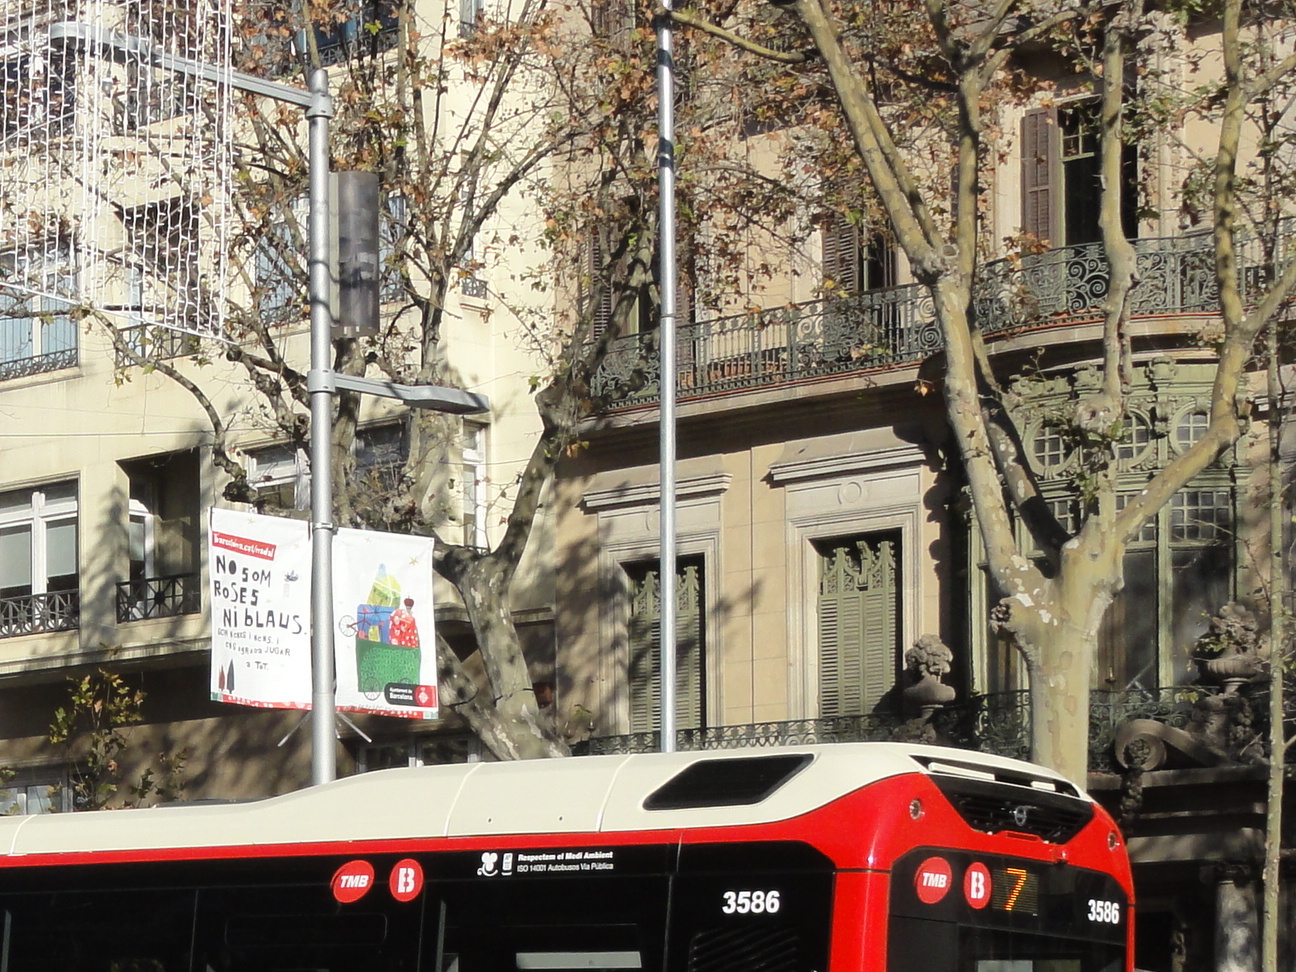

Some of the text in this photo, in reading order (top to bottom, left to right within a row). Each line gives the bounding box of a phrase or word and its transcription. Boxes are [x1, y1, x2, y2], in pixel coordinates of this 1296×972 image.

[216, 555, 237, 575] NO
[518, 854, 556, 862] Respectem
[565, 852, 582, 860] Medi
[584, 851, 613, 859] Ambient
[517, 864, 529, 872] ISO
[340, 875, 369, 888] TMB
[397, 867, 415, 893] B
[922, 872, 948, 888] TMB
[970, 871, 985, 900] B
[1004, 867, 1027, 911] 7
[722, 890, 780, 914] 3586
[1087, 899, 1120, 925] 3586
